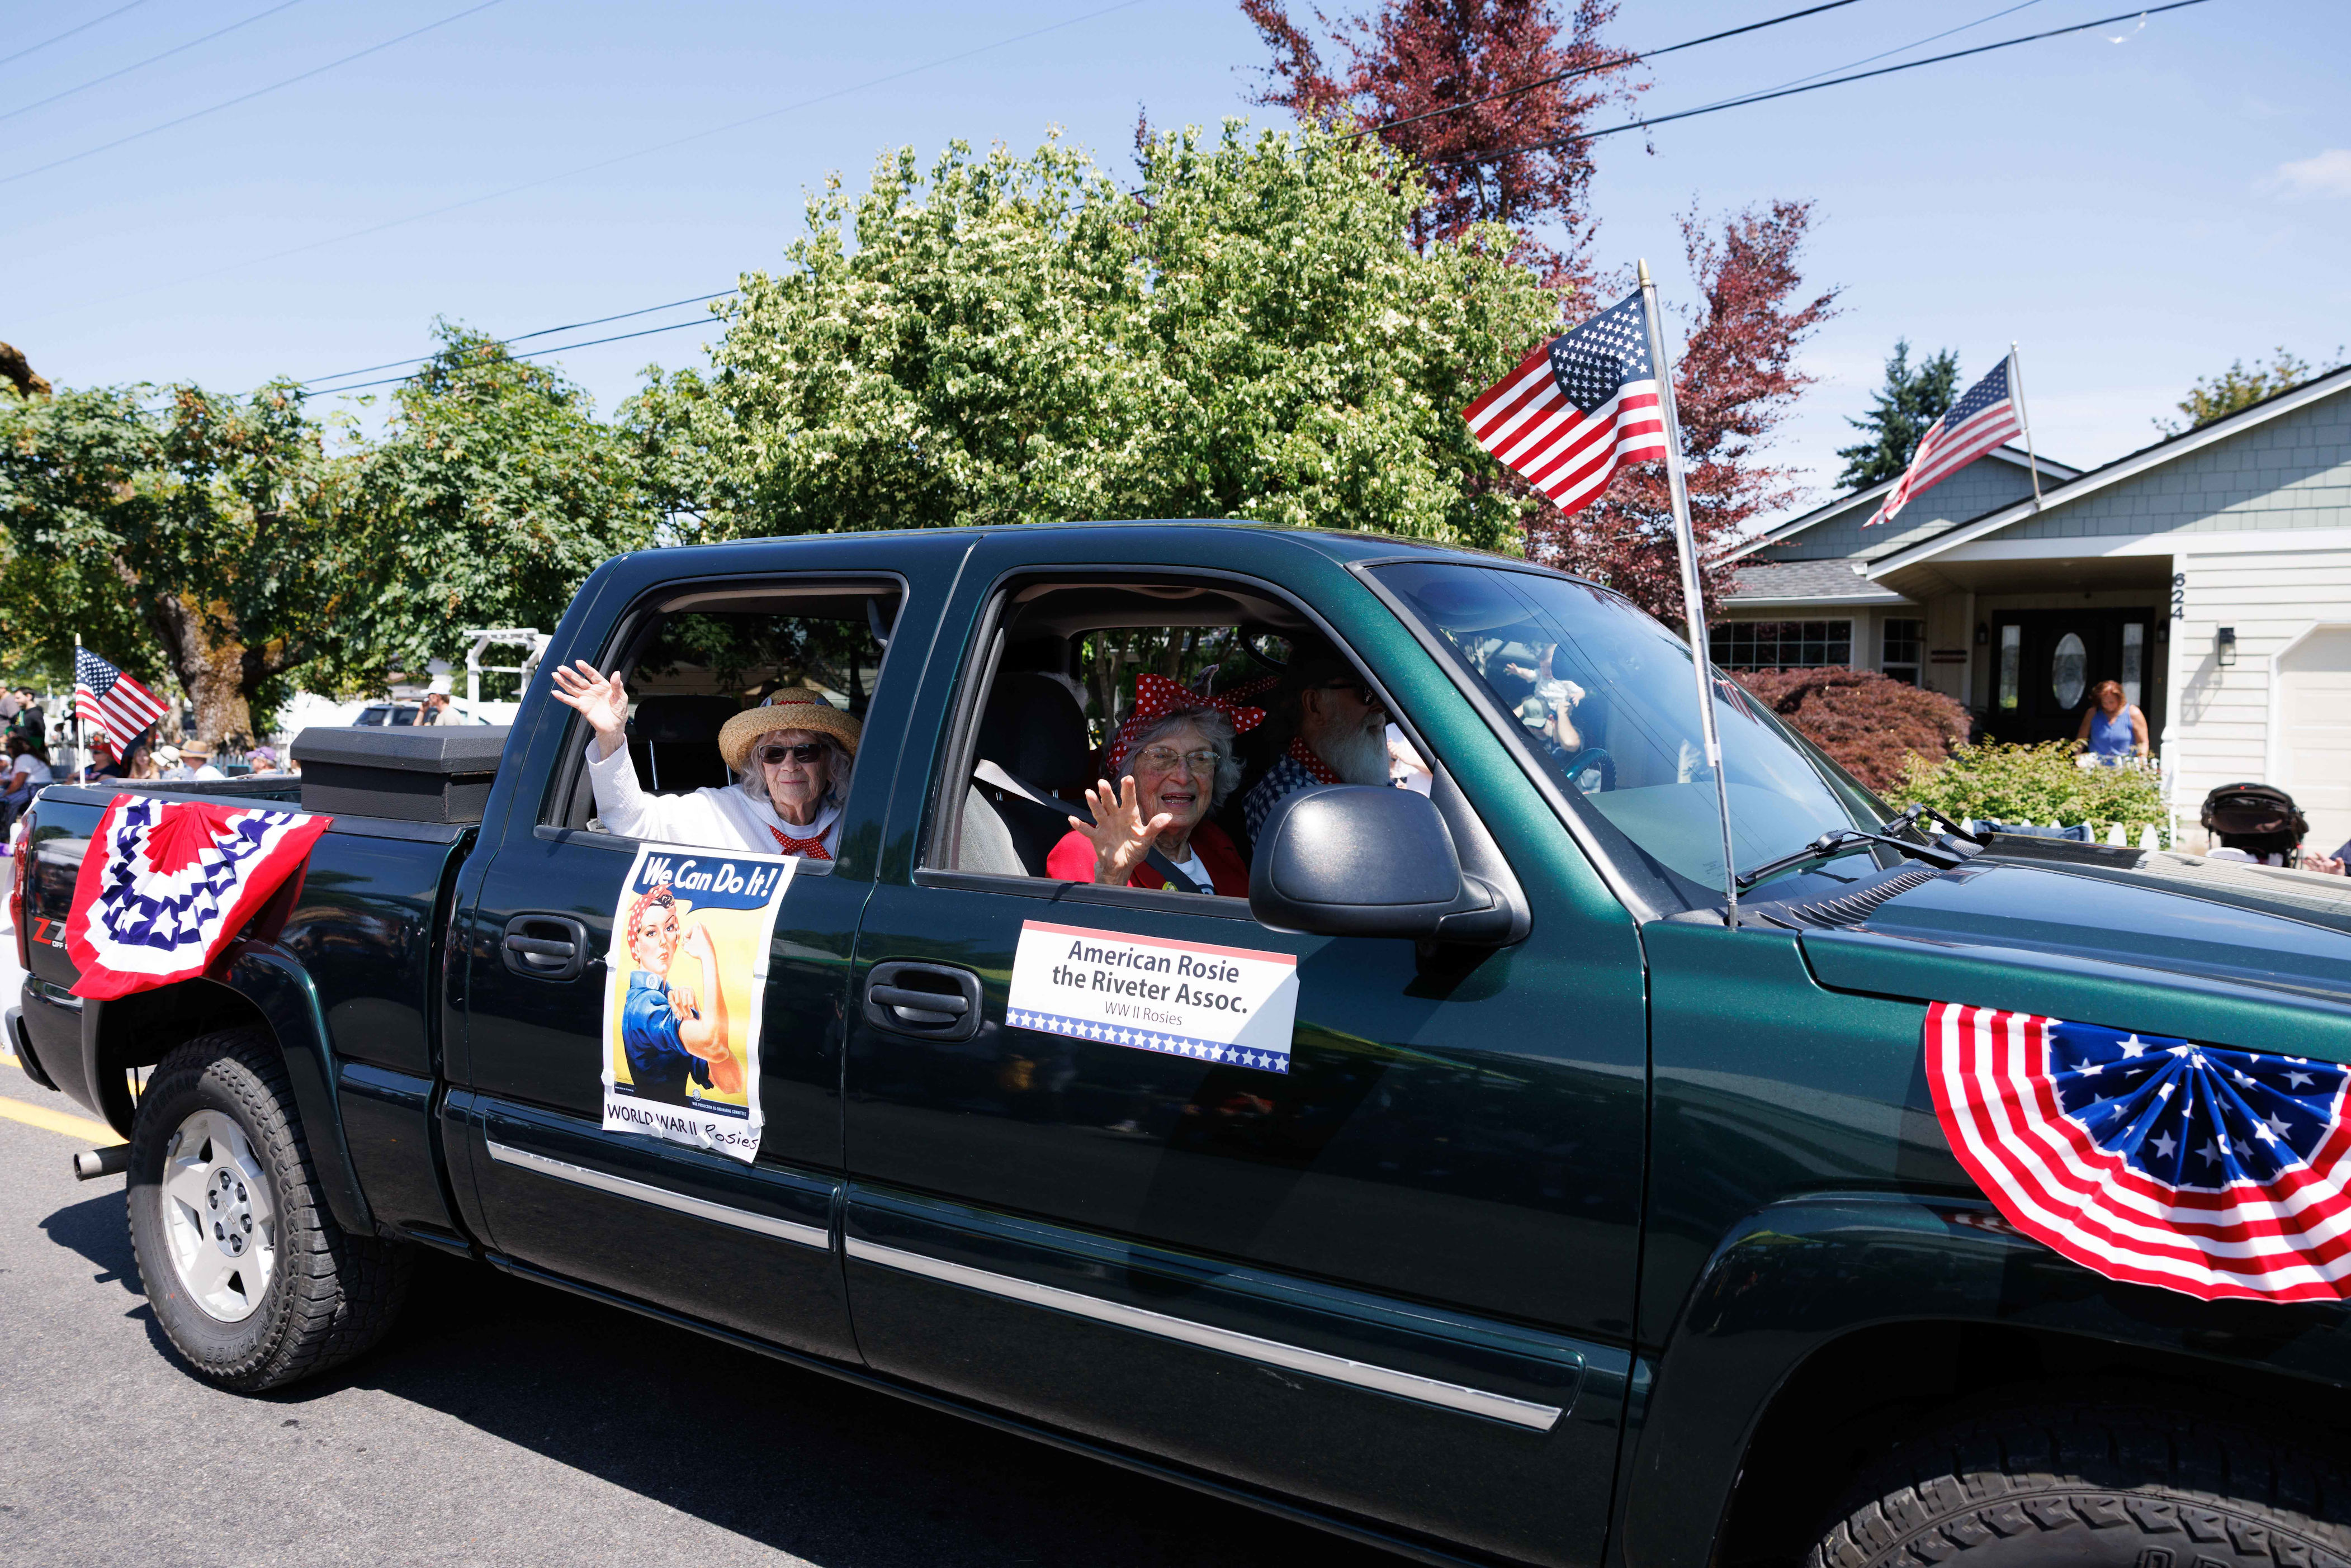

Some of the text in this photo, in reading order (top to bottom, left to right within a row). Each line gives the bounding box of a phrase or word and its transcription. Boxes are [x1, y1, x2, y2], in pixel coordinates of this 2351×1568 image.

[2172, 573, 2185, 620] 624
[642, 856, 779, 897] We Can Do It!
[52, 940, 64, 949] OFF
[1067, 940, 1240, 983] American Rosie
[1052, 965, 1247, 1013] the Riveter Assoc.
[1105, 1001, 1183, 1026] WW II Rosies
[607, 1103, 759, 1149] WORLD WAR II Rosies
[205, 1329, 257, 1364] RANGE
